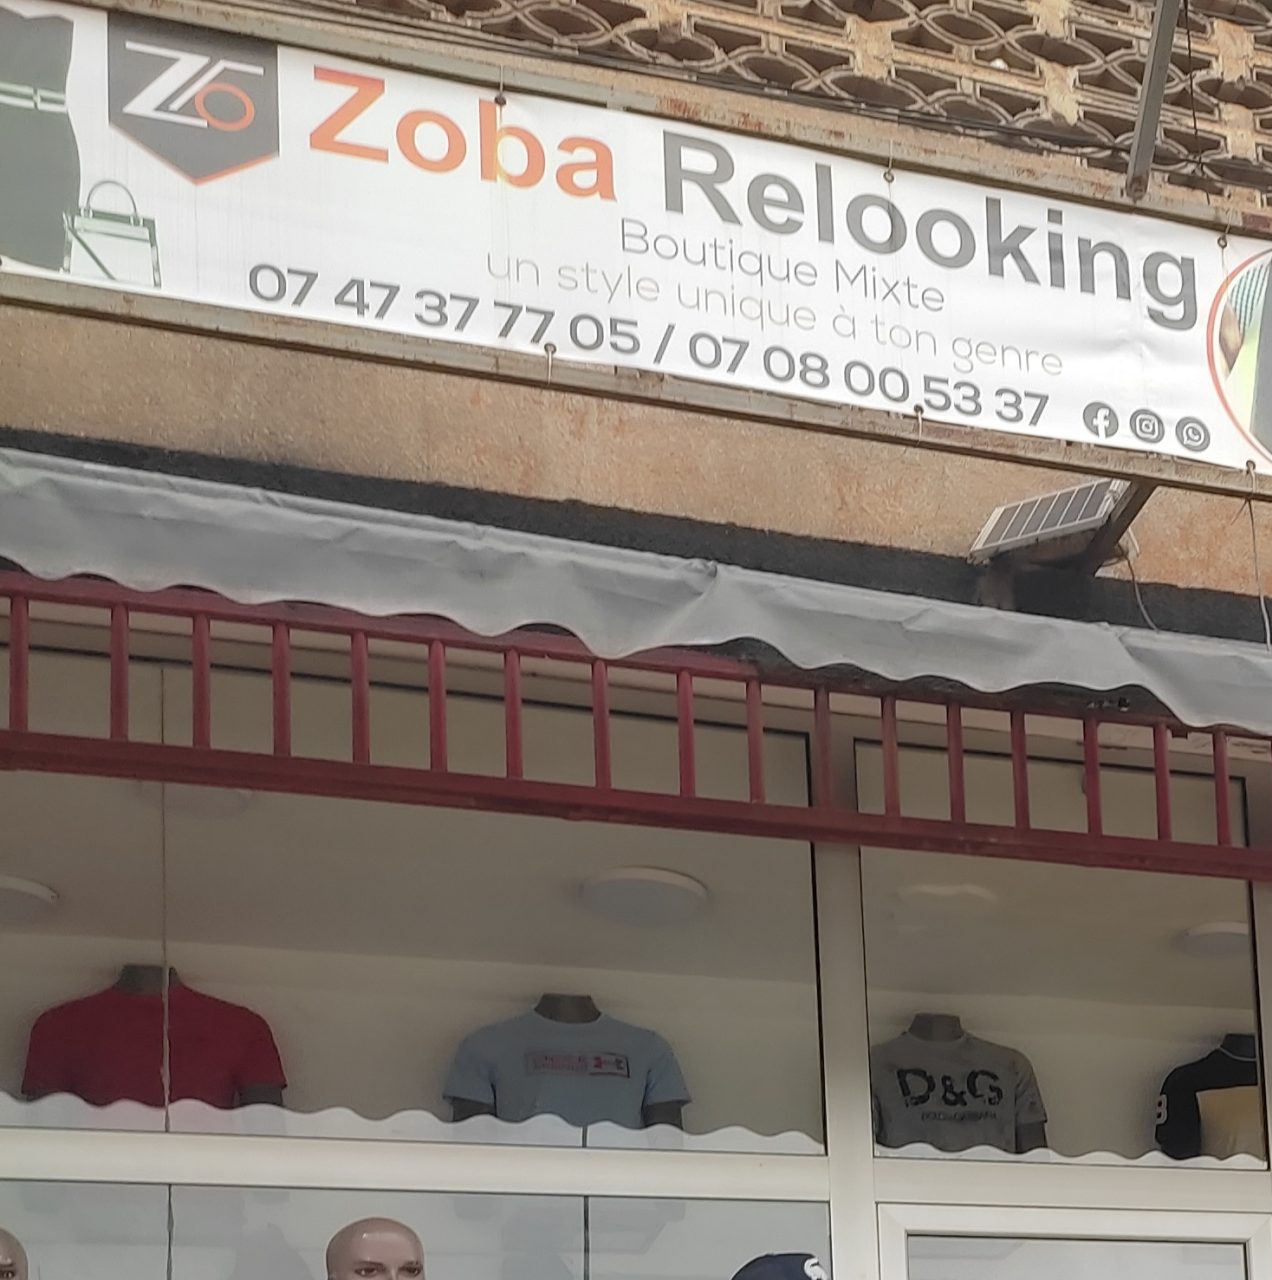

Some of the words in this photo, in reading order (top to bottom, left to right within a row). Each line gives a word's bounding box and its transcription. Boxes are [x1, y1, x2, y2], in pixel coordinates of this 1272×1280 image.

[309, 64, 618, 203] Zoba
[662, 129, 1198, 331] Relooking
[487, 251, 540, 287] un
[557, 261, 660, 305] style
[677, 282, 817, 332] unique
[831, 303, 857, 340] à
[870, 313, 937, 357] ton
[951, 335, 1063, 377] genre
[621, 218, 818, 287] Boutique
[835, 258, 945, 312] Mixte
[248, 263, 319, 307] 07
[333, 278, 401, 321] 47
[414, 289, 480, 333] 37
[493, 300, 556, 345] 77
[569, 313, 641, 355] 05
[652, 323, 676, 365] /
[688, 332, 750, 375] 07
[762, 345, 831, 389] 08
[843, 359, 910, 404] 00
[922, 374, 983, 417] 53
[994, 387, 1050, 427] 37
[896, 1067, 1004, 1108] D&G
